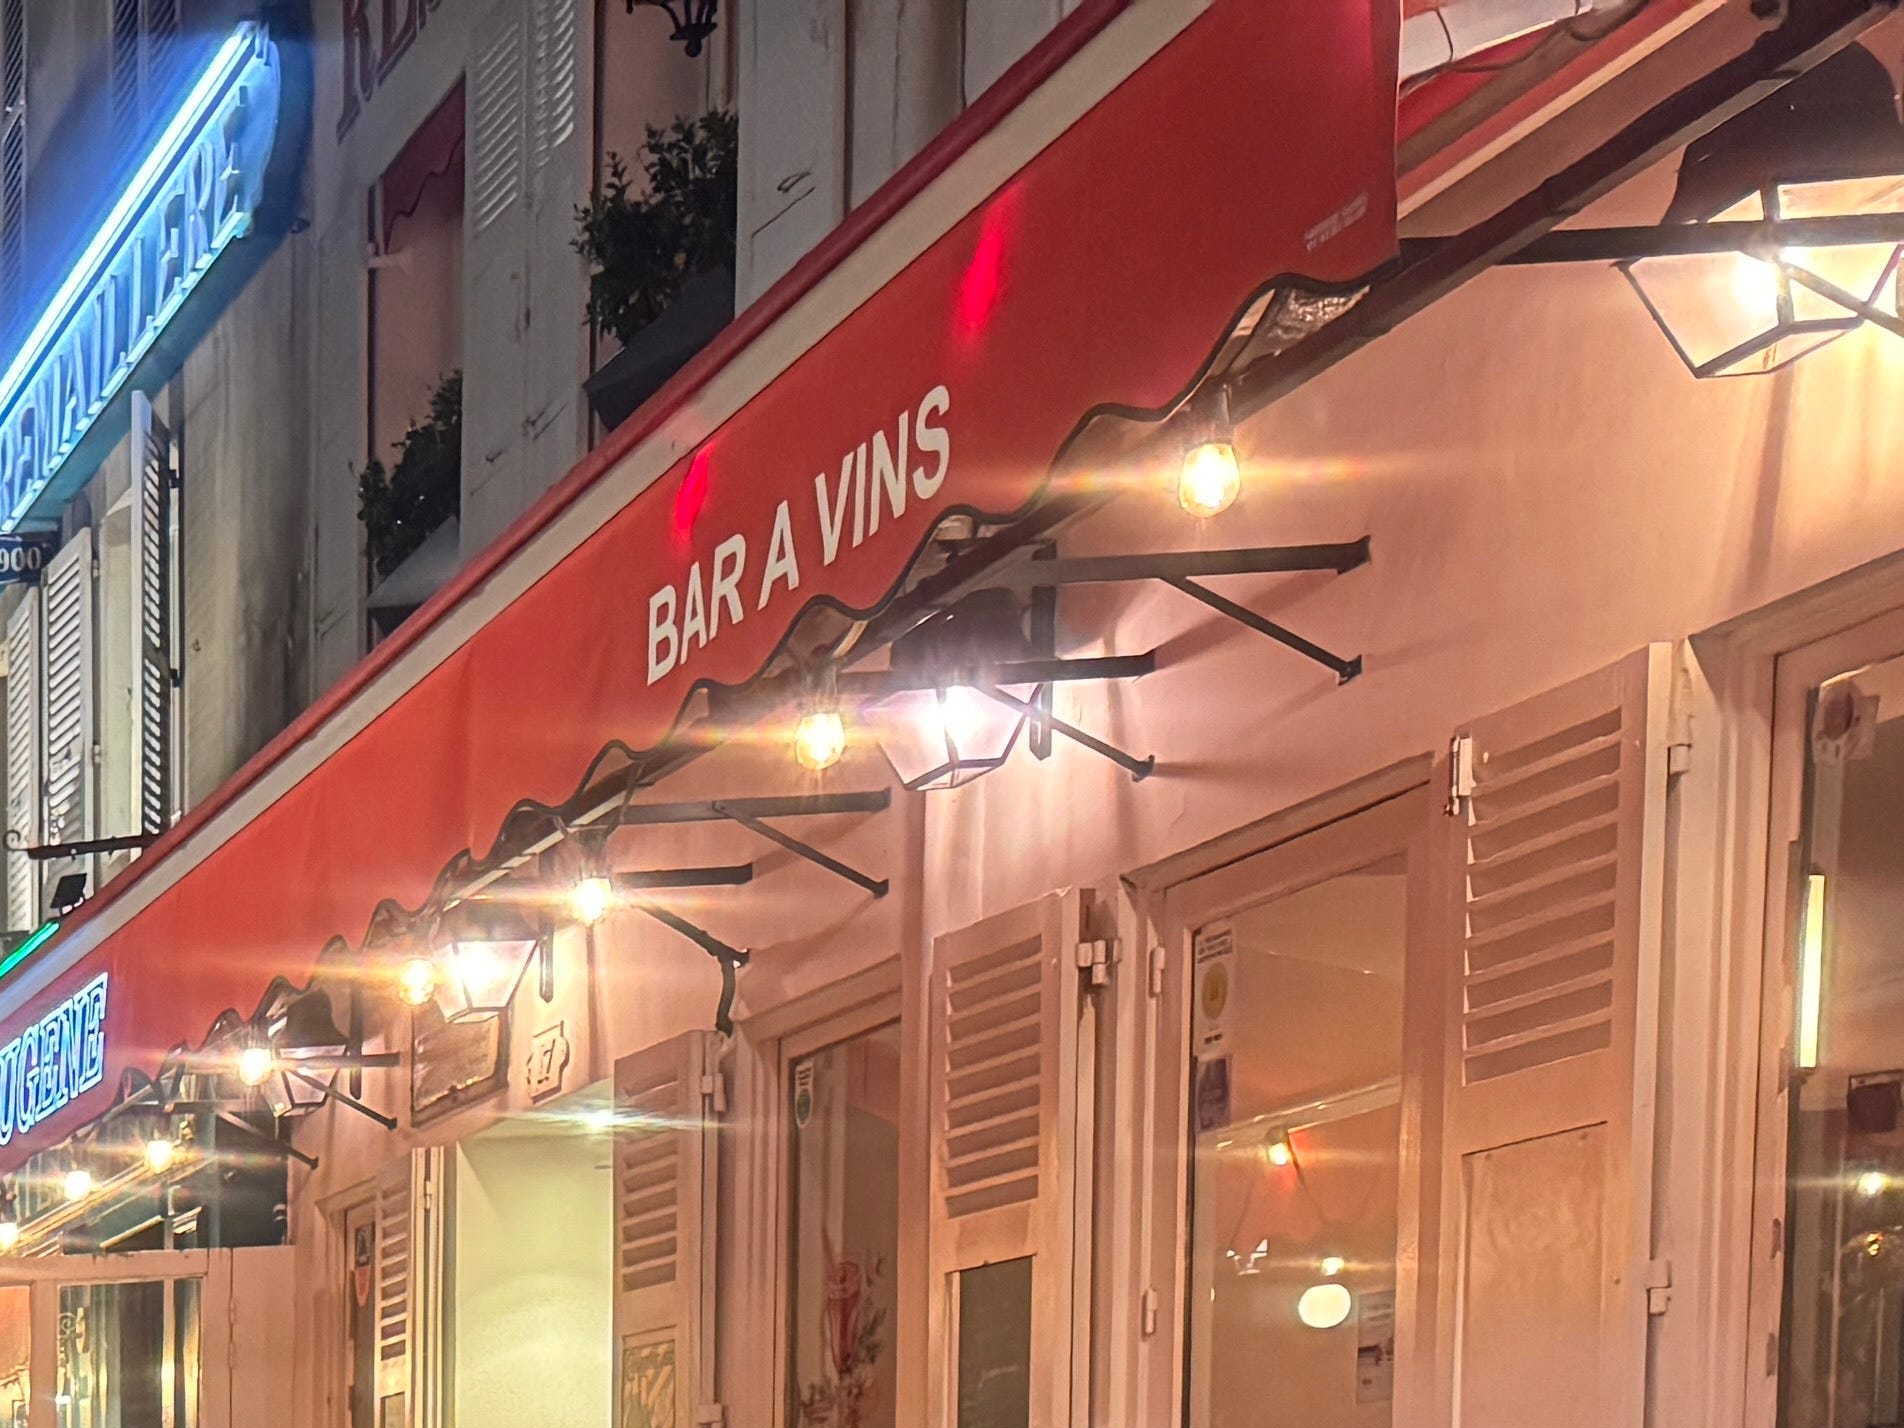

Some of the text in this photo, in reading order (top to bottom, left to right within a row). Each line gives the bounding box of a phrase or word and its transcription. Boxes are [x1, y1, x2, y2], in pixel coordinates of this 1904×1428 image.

[647, 385, 950, 687] BAR A VINS
